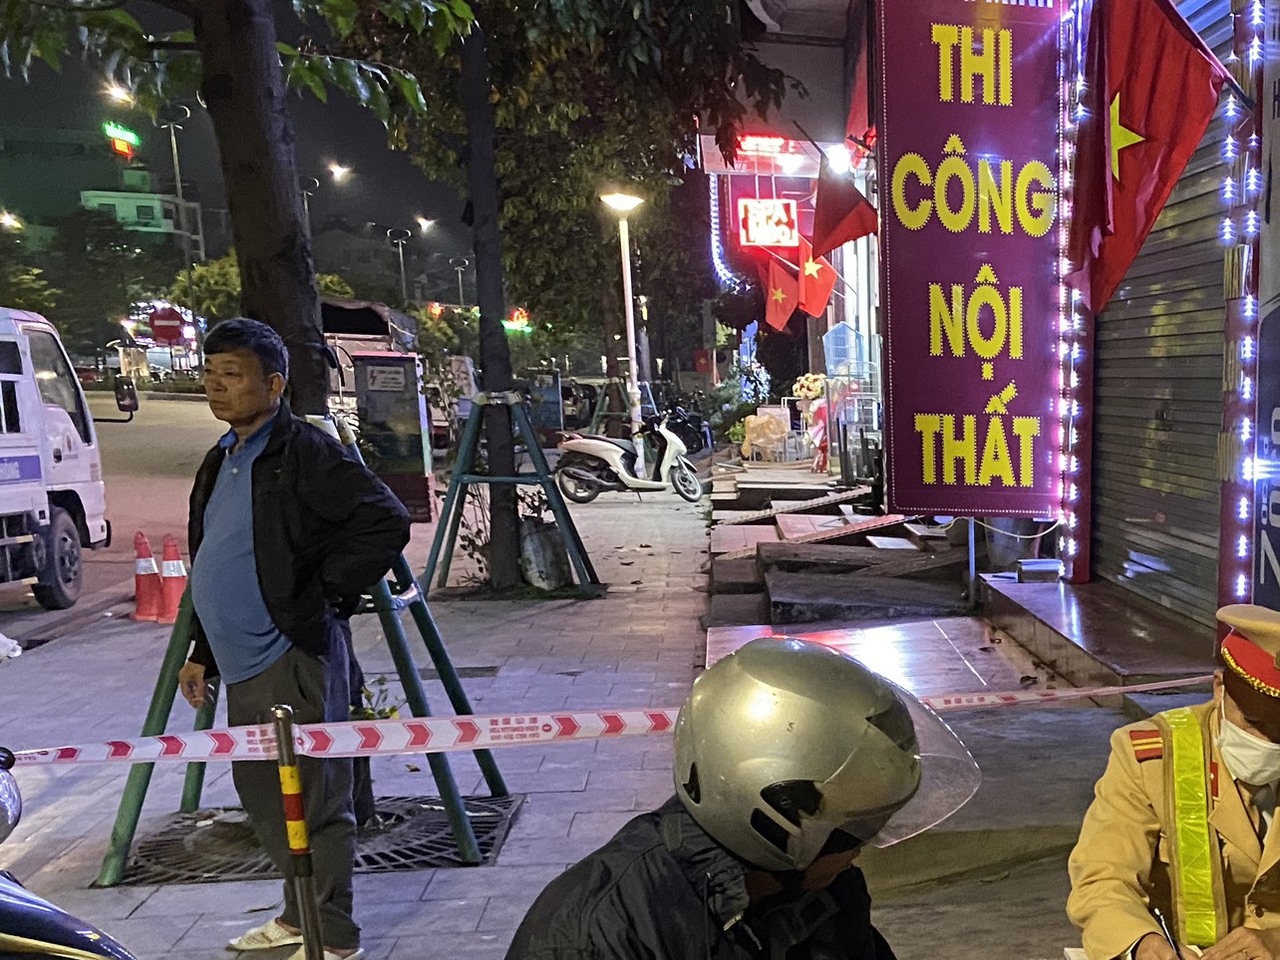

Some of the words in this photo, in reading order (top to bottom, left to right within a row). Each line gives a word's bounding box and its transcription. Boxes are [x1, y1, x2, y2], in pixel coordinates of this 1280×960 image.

[931, 23, 1013, 106] THI
[891, 134, 1058, 237] CÔNG
[929, 263, 1023, 380] NỘI
[914, 380, 1040, 487] THẤT
